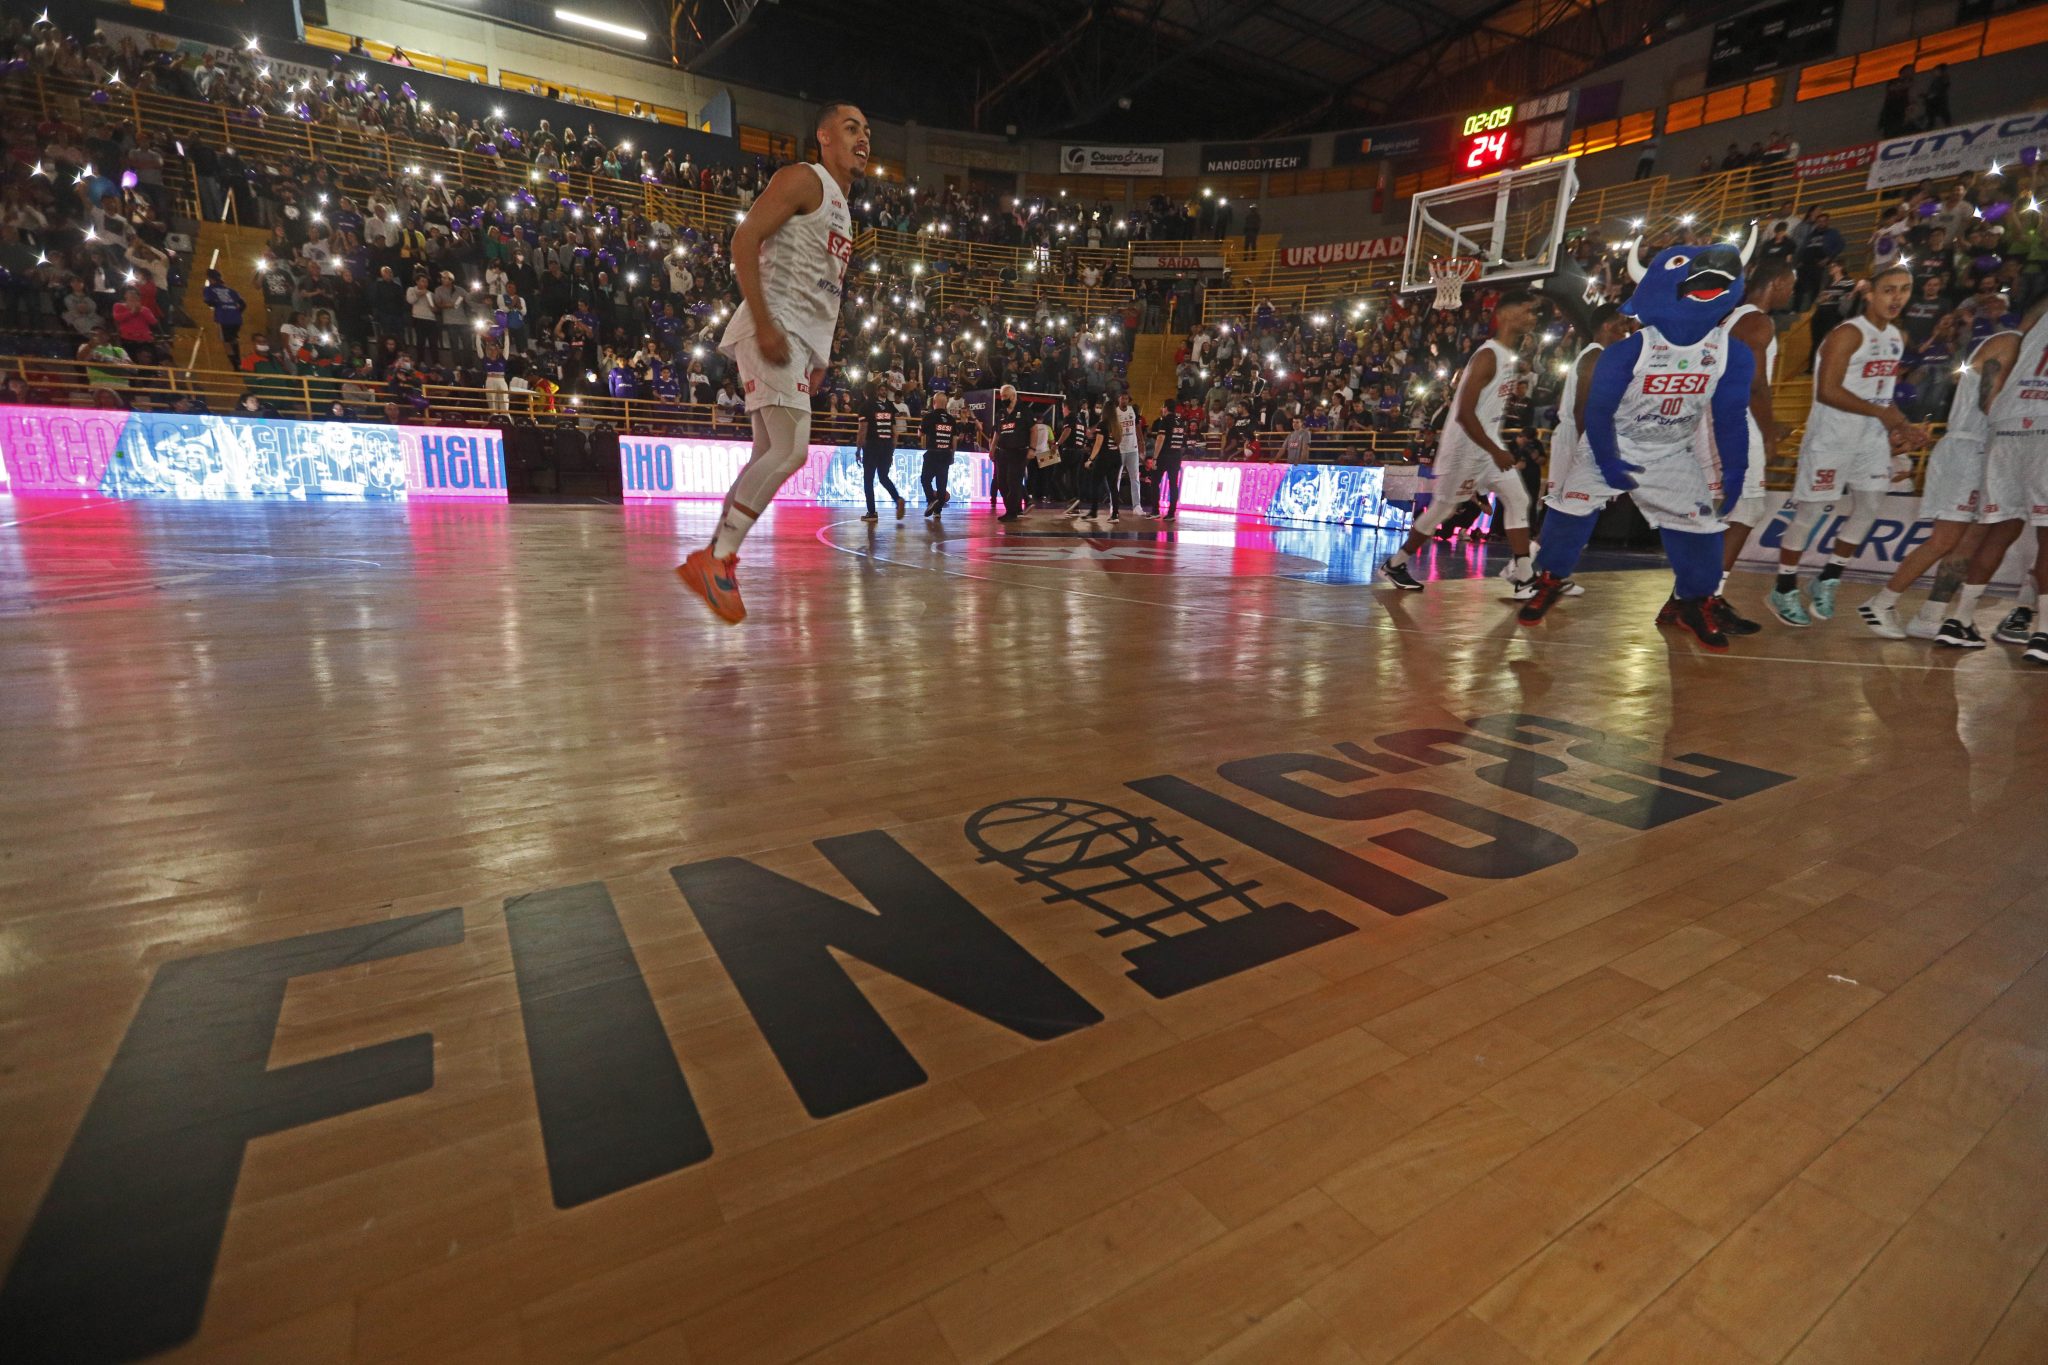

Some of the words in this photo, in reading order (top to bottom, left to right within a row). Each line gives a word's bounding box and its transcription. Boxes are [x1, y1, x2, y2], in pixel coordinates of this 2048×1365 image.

[1464, 106, 1513, 136] 02:09
[1467, 131, 1508, 168] 24
[1880, 123, 1995, 161] CITY
[1207, 158, 1298, 172] NANOBODYTECH
[1648, 375, 1704, 393] SESI
[1659, 397, 1684, 416] 00
